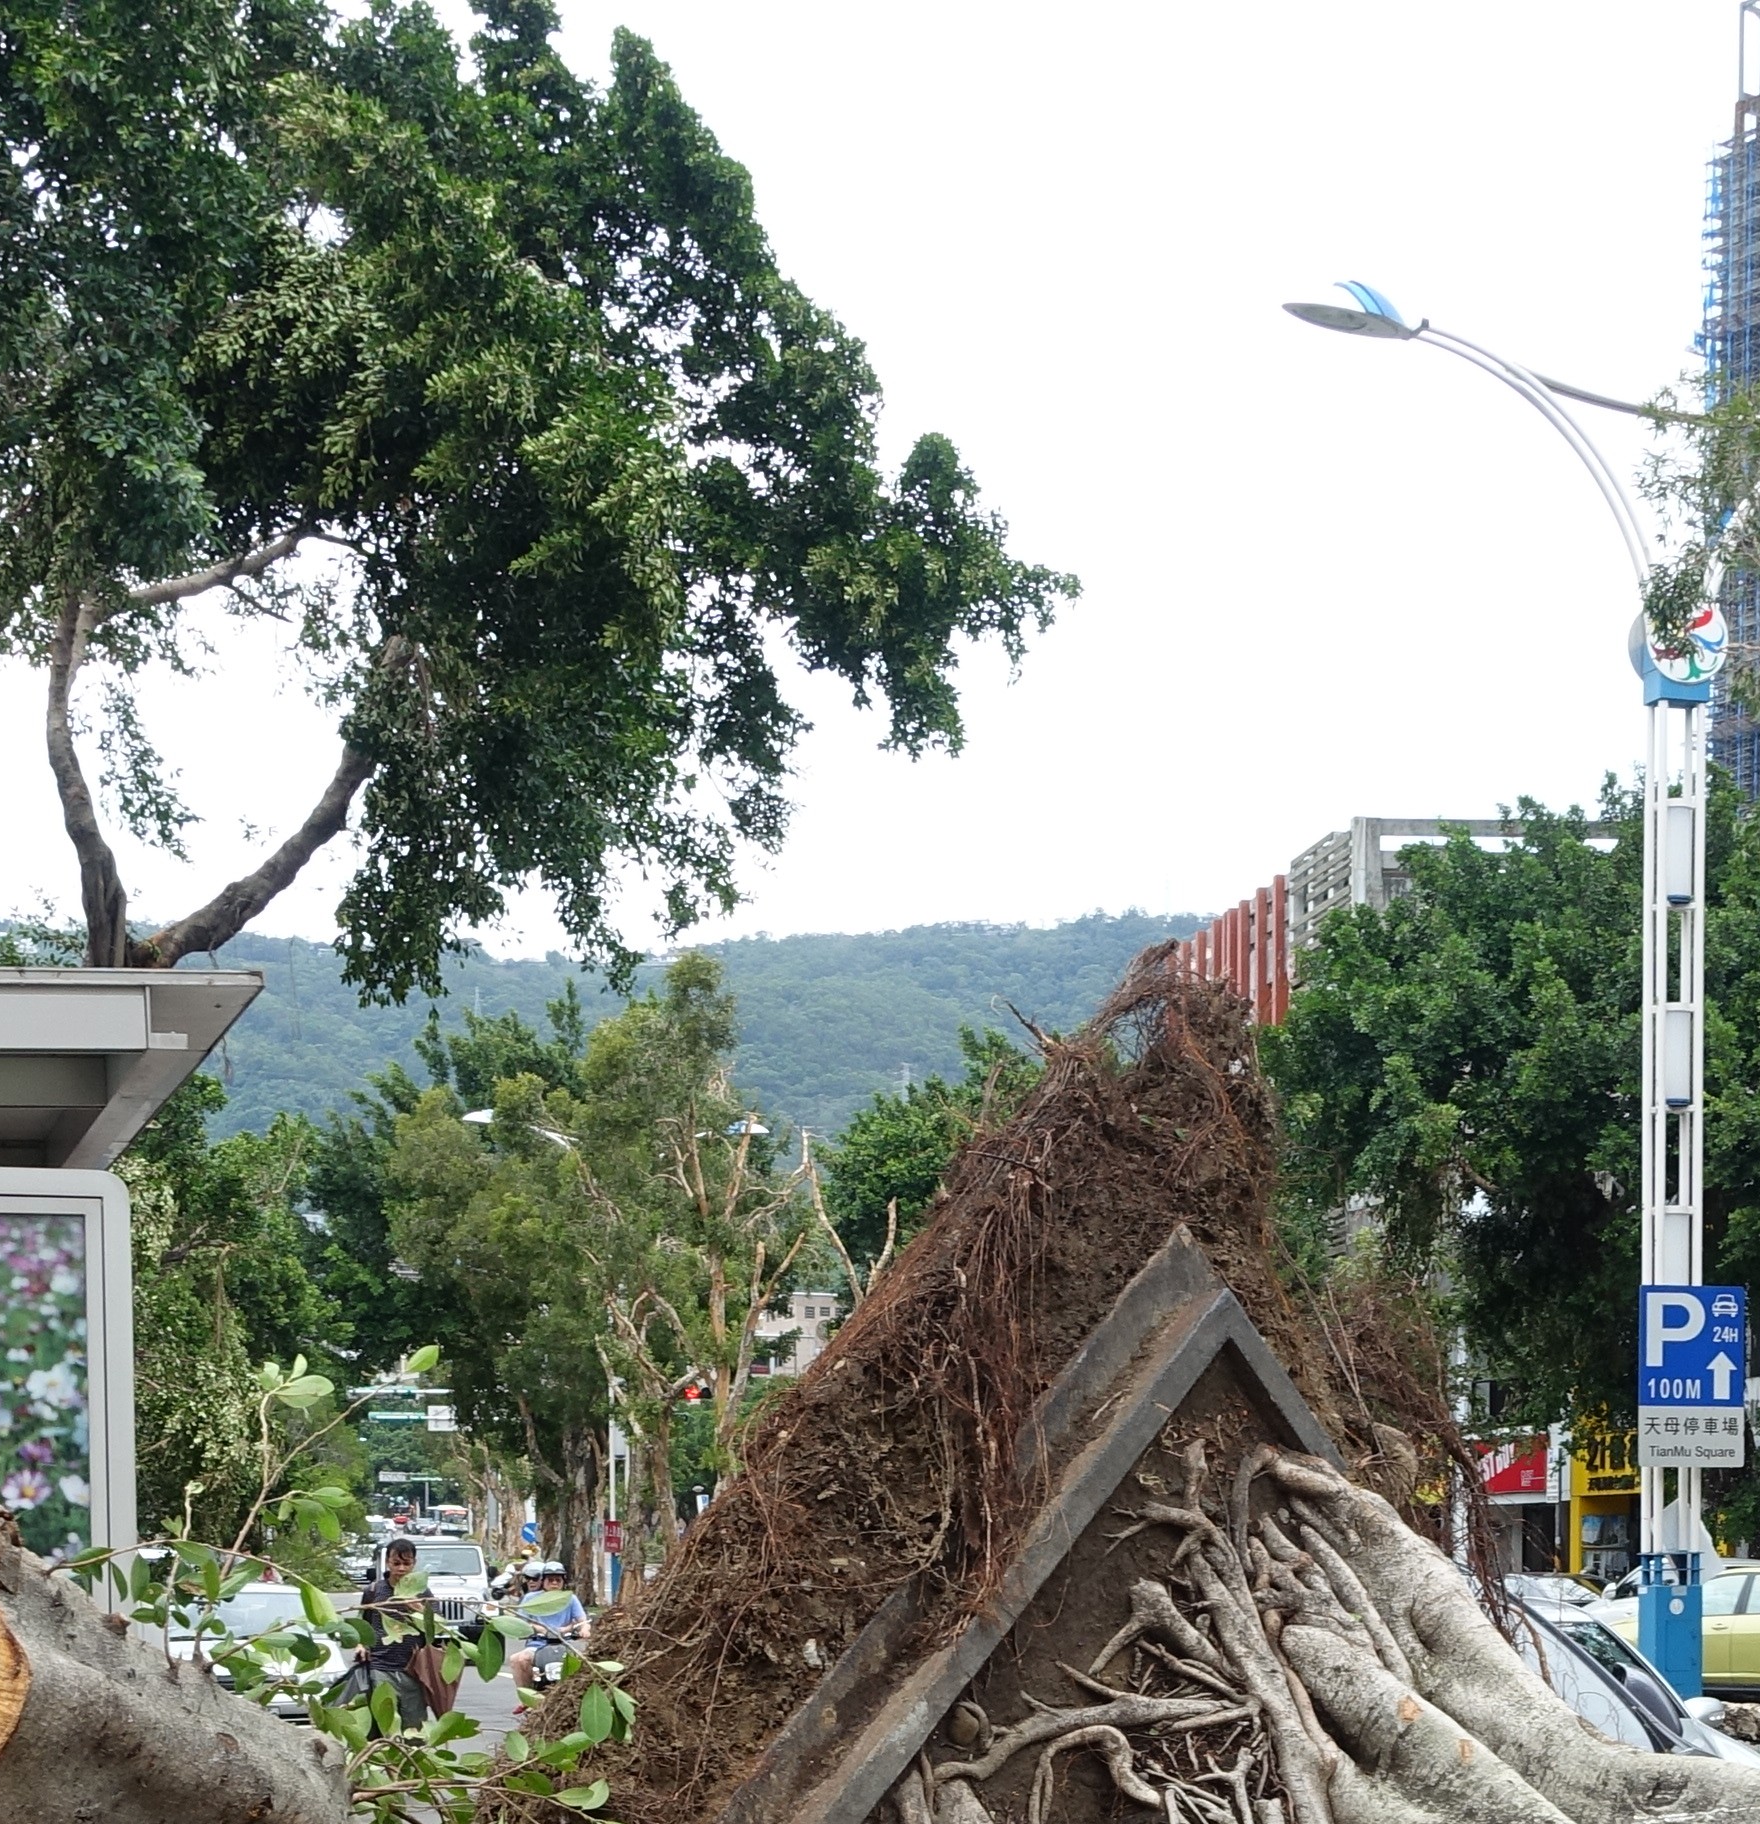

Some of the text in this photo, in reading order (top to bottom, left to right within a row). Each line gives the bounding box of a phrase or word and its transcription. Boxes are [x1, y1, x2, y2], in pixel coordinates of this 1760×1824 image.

[1646, 1292, 1706, 1367] P
[1712, 1326, 1739, 1343] 24H
[1648, 1378, 1701, 1399] 100M
[1644, 1417, 1739, 1436] 天母停車場
[1649, 1445, 1736, 1459] TianMu Square
